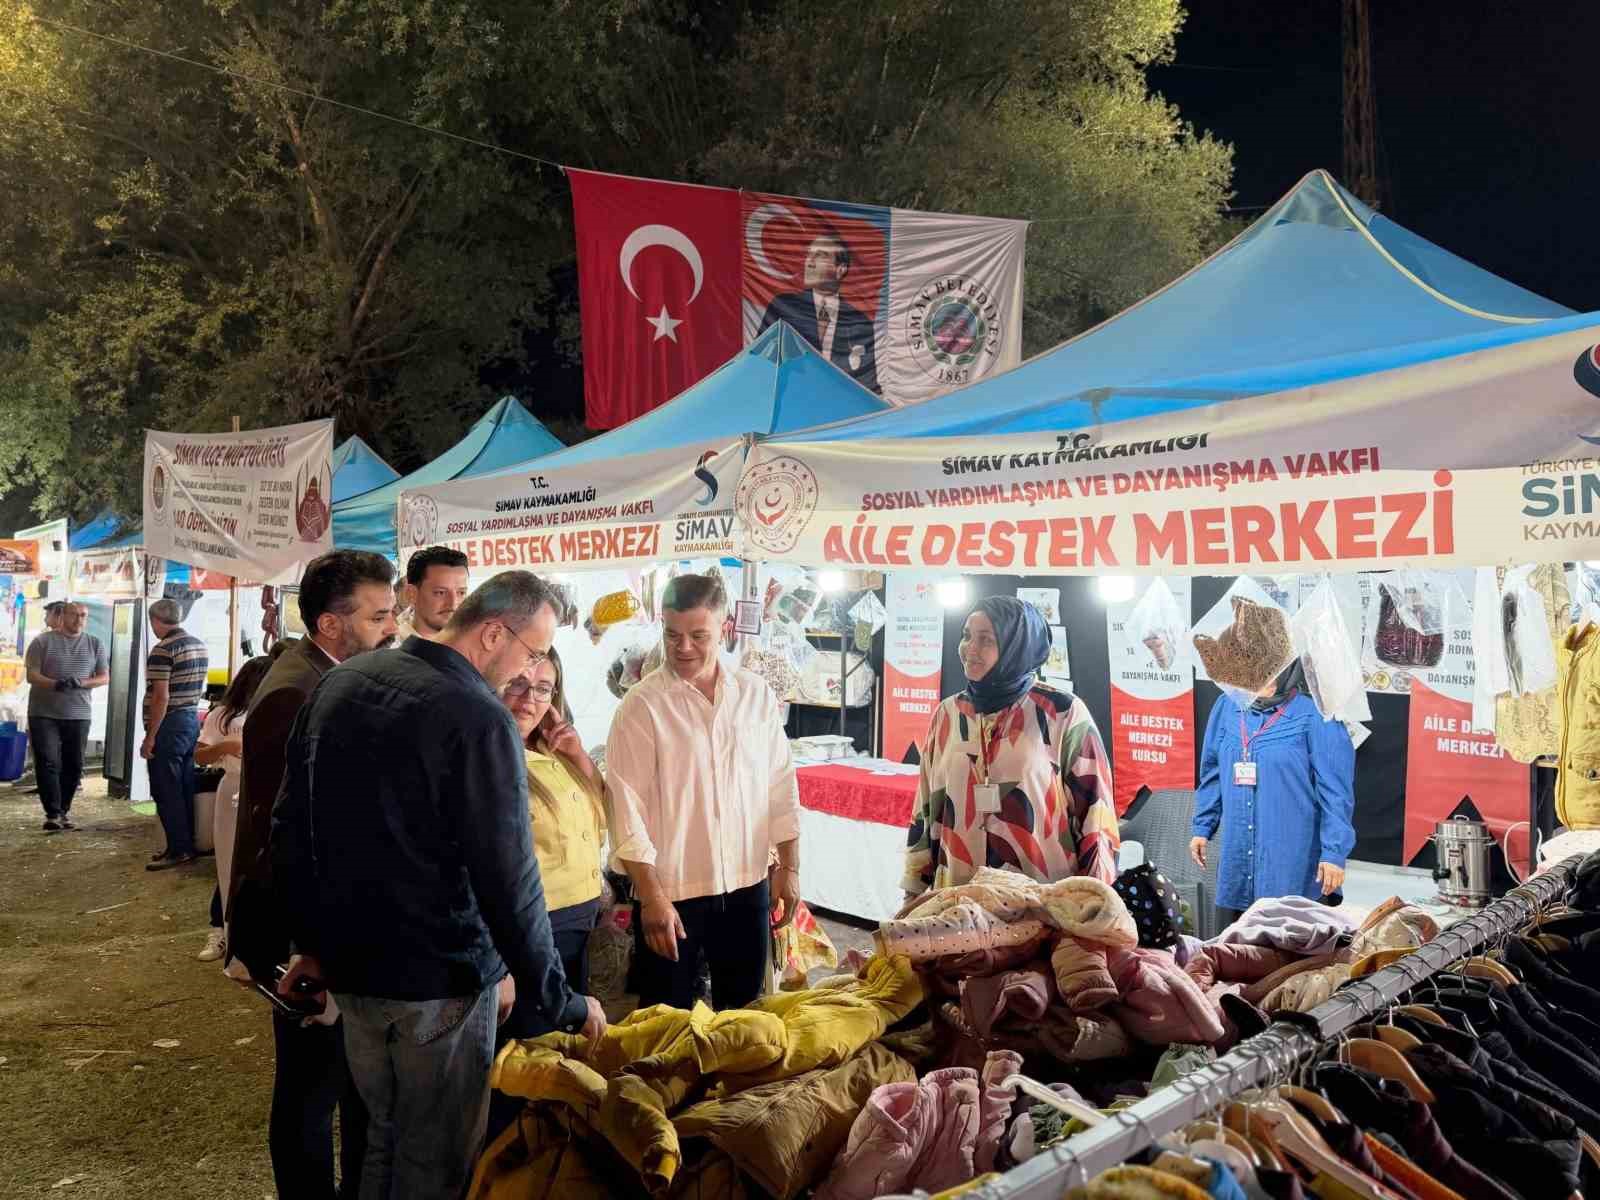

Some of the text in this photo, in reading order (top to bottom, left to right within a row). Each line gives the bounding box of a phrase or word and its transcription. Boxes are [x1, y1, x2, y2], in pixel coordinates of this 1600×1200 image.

[938, 368, 969, 381] 1867
[530, 476, 549, 489] T.C.
[862, 447, 1380, 511] SOSYAL YARDIMLAŞMA VE DAYANIŞMA VAKFI
[523, 486, 596, 509] KAYMAKAMLIĞI
[447, 522, 478, 534] SOSYAL
[480, 513, 544, 530] YARDIMLAŞMA
[546, 512, 559, 525] VE
[561, 506, 617, 524] DAYANIŞMA
[621, 500, 654, 517] VAKFI
[823, 468, 1454, 568] AİLE DESTEK MERKEZİ
[1524, 521, 1600, 541] KAYM
[482, 534, 555, 567] DESTEK
[559, 524, 662, 562] MERKEZİ
[1120, 712, 1184, 731] AİLE DESTEK
[1424, 713, 1457, 733] AİLE
[1128, 731, 1173, 748] MERKEZİ
[1132, 748, 1167, 766] KURSU
